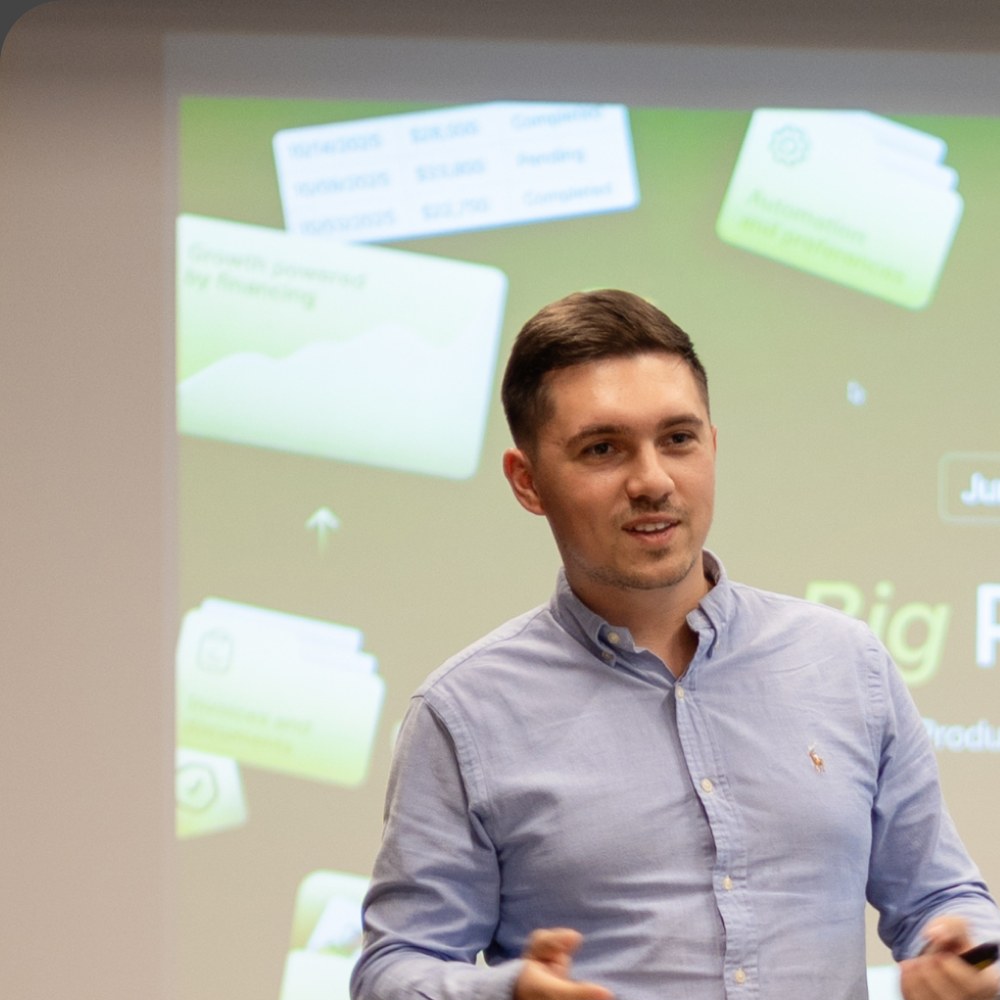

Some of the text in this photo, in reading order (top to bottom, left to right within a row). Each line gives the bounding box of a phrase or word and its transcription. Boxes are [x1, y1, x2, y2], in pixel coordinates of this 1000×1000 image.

[523, 182, 612, 205] Completed
[189, 243, 367, 289] Growth powered
[184, 267, 317, 312] by financing
